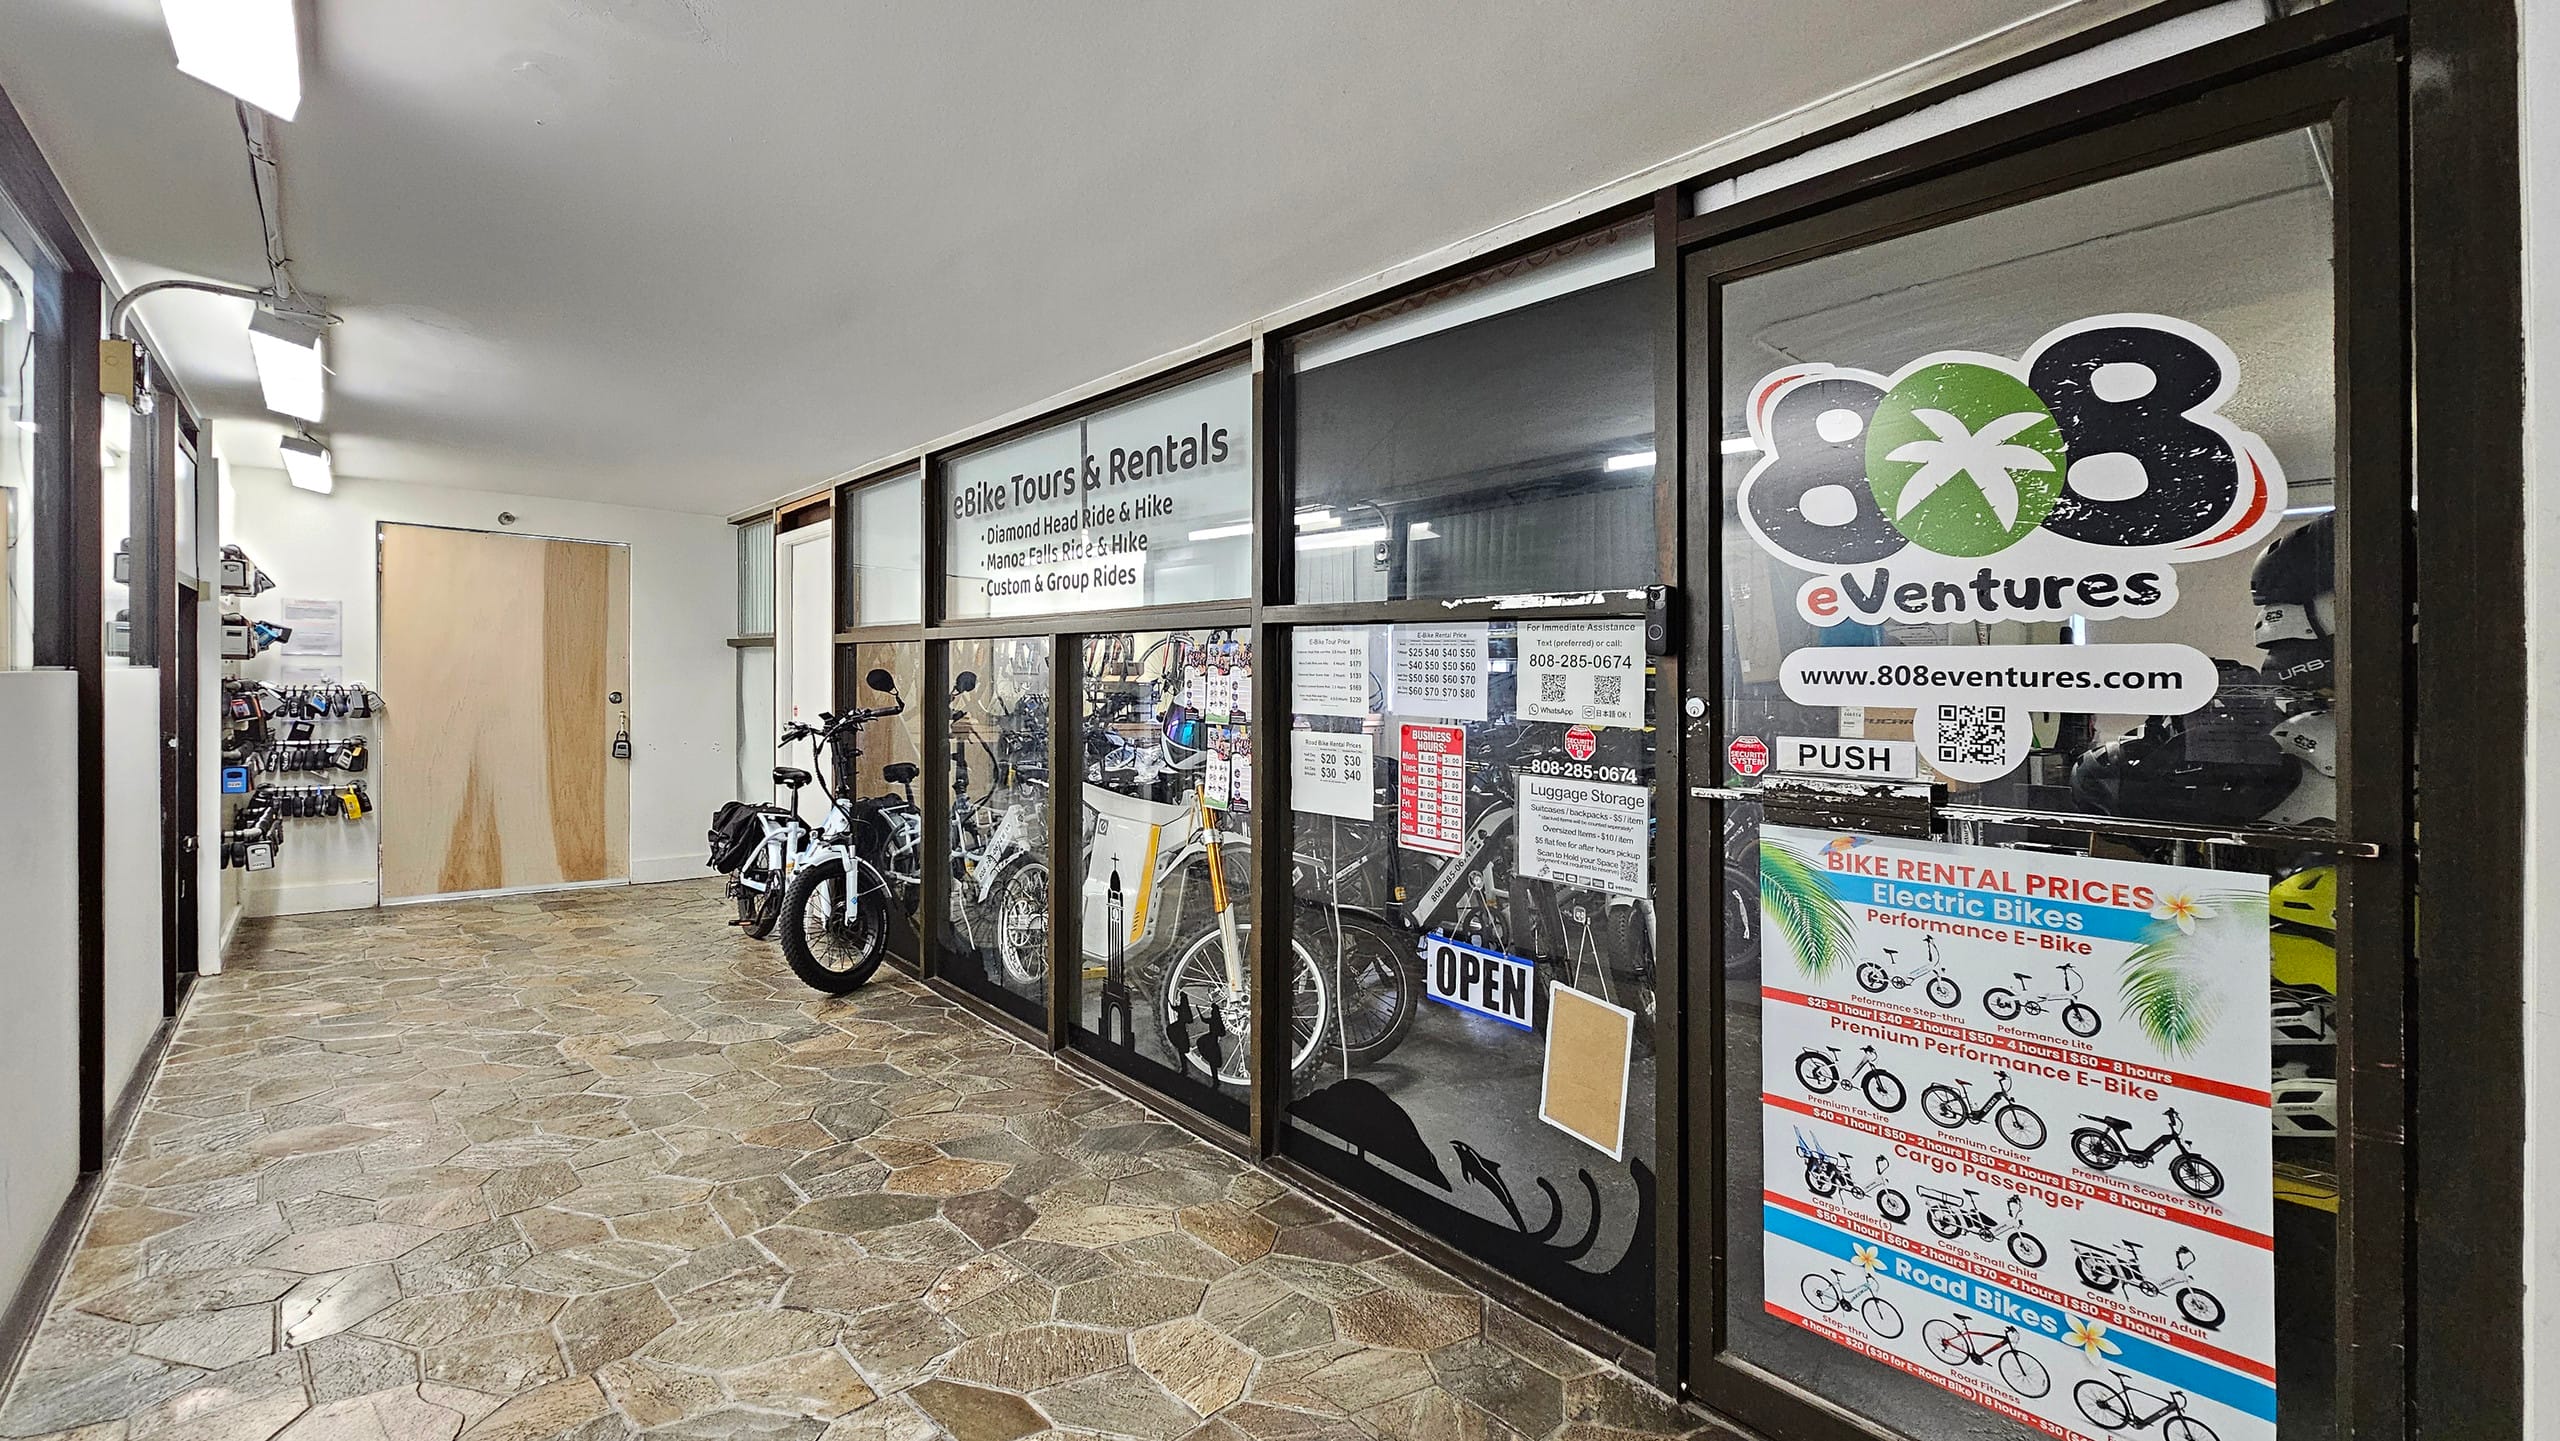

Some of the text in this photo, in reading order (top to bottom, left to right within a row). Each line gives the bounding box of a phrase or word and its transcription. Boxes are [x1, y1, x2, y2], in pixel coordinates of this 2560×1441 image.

[953, 423, 1229, 519] eBike Tours & Rentals
[987, 495, 1173, 545] Diamond Head Ride & Hike
[987, 531, 1148, 571] Manoa Falls Ride & Hike
[986, 565, 1136, 597] Custom & Group Rides
[1806, 567, 2162, 617] eVentures
[1526, 623, 1636, 632] For Immediate Assistance
[1408, 648, 1423, 658] $25
[1424, 648, 1439, 658] $40
[1442, 648, 1458, 658] $40
[1460, 648, 1476, 658] $50
[1553, 640, 1594, 648] (preferred)
[1408, 660, 1476, 672] $40 $50 $50 $60
[1529, 653, 1632, 669] 808-285-0674
[1408, 674, 1423, 683] $50
[1424, 674, 1439, 683] $60
[1442, 675, 1458, 684] $60
[1460, 675, 1476, 685] $70
[1799, 663, 2183, 691] www.808eventures.com
[1408, 686, 1423, 696] $60
[1424, 686, 1439, 696] $70
[1442, 688, 1458, 698] $70
[1460, 689, 1476, 699] $80
[1540, 706, 1574, 716] WhatsApp
[1412, 730, 1451, 743] BUSINESS
[1417, 741, 1447, 752] HOURS:
[1320, 753, 1337, 765] $20
[1343, 754, 1361, 767] $30
[1402, 751, 1417, 761] Mon.
[1402, 763, 1418, 773] Tues.
[1730, 750, 1767, 759] SECURITY
[1731, 757, 1766, 766] SYSTEM
[1799, 743, 1891, 772] PUSH
[1320, 767, 1337, 778] $30
[1343, 769, 1361, 781] $40
[1402, 775, 1417, 785] Wed.
[1531, 759, 1638, 784] 808-285-0674
[1530, 783, 1645, 810] Luggage Storage
[1530, 803, 1644, 825] Suitcases backpacks $5 item
[1542, 825, 1577, 836] Oversized
[1601, 833, 1614, 842] $10
[1618, 836, 1634, 845] item
[1537, 849, 1619, 869] Scan Hold your Space
[1578, 843, 1594, 852] after
[1596, 846, 1616, 856] hours
[1616, 849, 1641, 860] pickup
[1431, 851, 1471, 902] 808-285-064
[1828, 851, 2155, 910] BIKE RENTAL PRICES
[1873, 882, 2084, 931] Electric Bikes
[1867, 909, 2093, 955] Performance E-Bike
[1436, 946, 1526, 1020] OPEN
[1851, 994, 1965, 1025] Peformance Step-thru
[1807, 996, 2173, 1083] $25 hour $40 hours $50 hours $60 hours
[1997, 1024, 2093, 1051] Peformance Lite
[1830, 1016, 2159, 1102] Premium Performance E-Bike
[1808, 1094, 1889, 1123] Premium Fat-tire
[1937, 1130, 2031, 1163] Premium Cruiser
[1813, 1107, 2167, 1217] $40 hour $50 hours $60 hours $70 hours
[1894, 1144, 2084, 1211] Cargo Passenger
[2072, 1167, 2224, 1217] Premium Scooter Style
[1812, 1196, 1893, 1231] Cargo Toddler(s)
[1937, 1240, 2038, 1281] Cargo Small Child
[1815, 1209, 2170, 1342] $50 hour $60 hours $70 hours $80 hours
[1895, 1258, 2058, 1334] Road Bikes
[1822, 1314, 1869, 1340] Step-thru
[2087, 1291, 2208, 1340] Cargo Small Adult
[1809, 1321, 1837, 1339] hours
[1846, 1336, 1864, 1350] $20
[1866, 1345, 1889, 1362] ($30
[1890, 1355, 1906, 1368] for
[1907, 1363, 1947, 1386] E-Road
[1948, 1378, 1977, 1401] Bike)
[1995, 1399, 2029, 1422] hours
[2040, 1420, 2063, 1437] $30
[1950, 1368, 2021, 1405] Road Fitness
